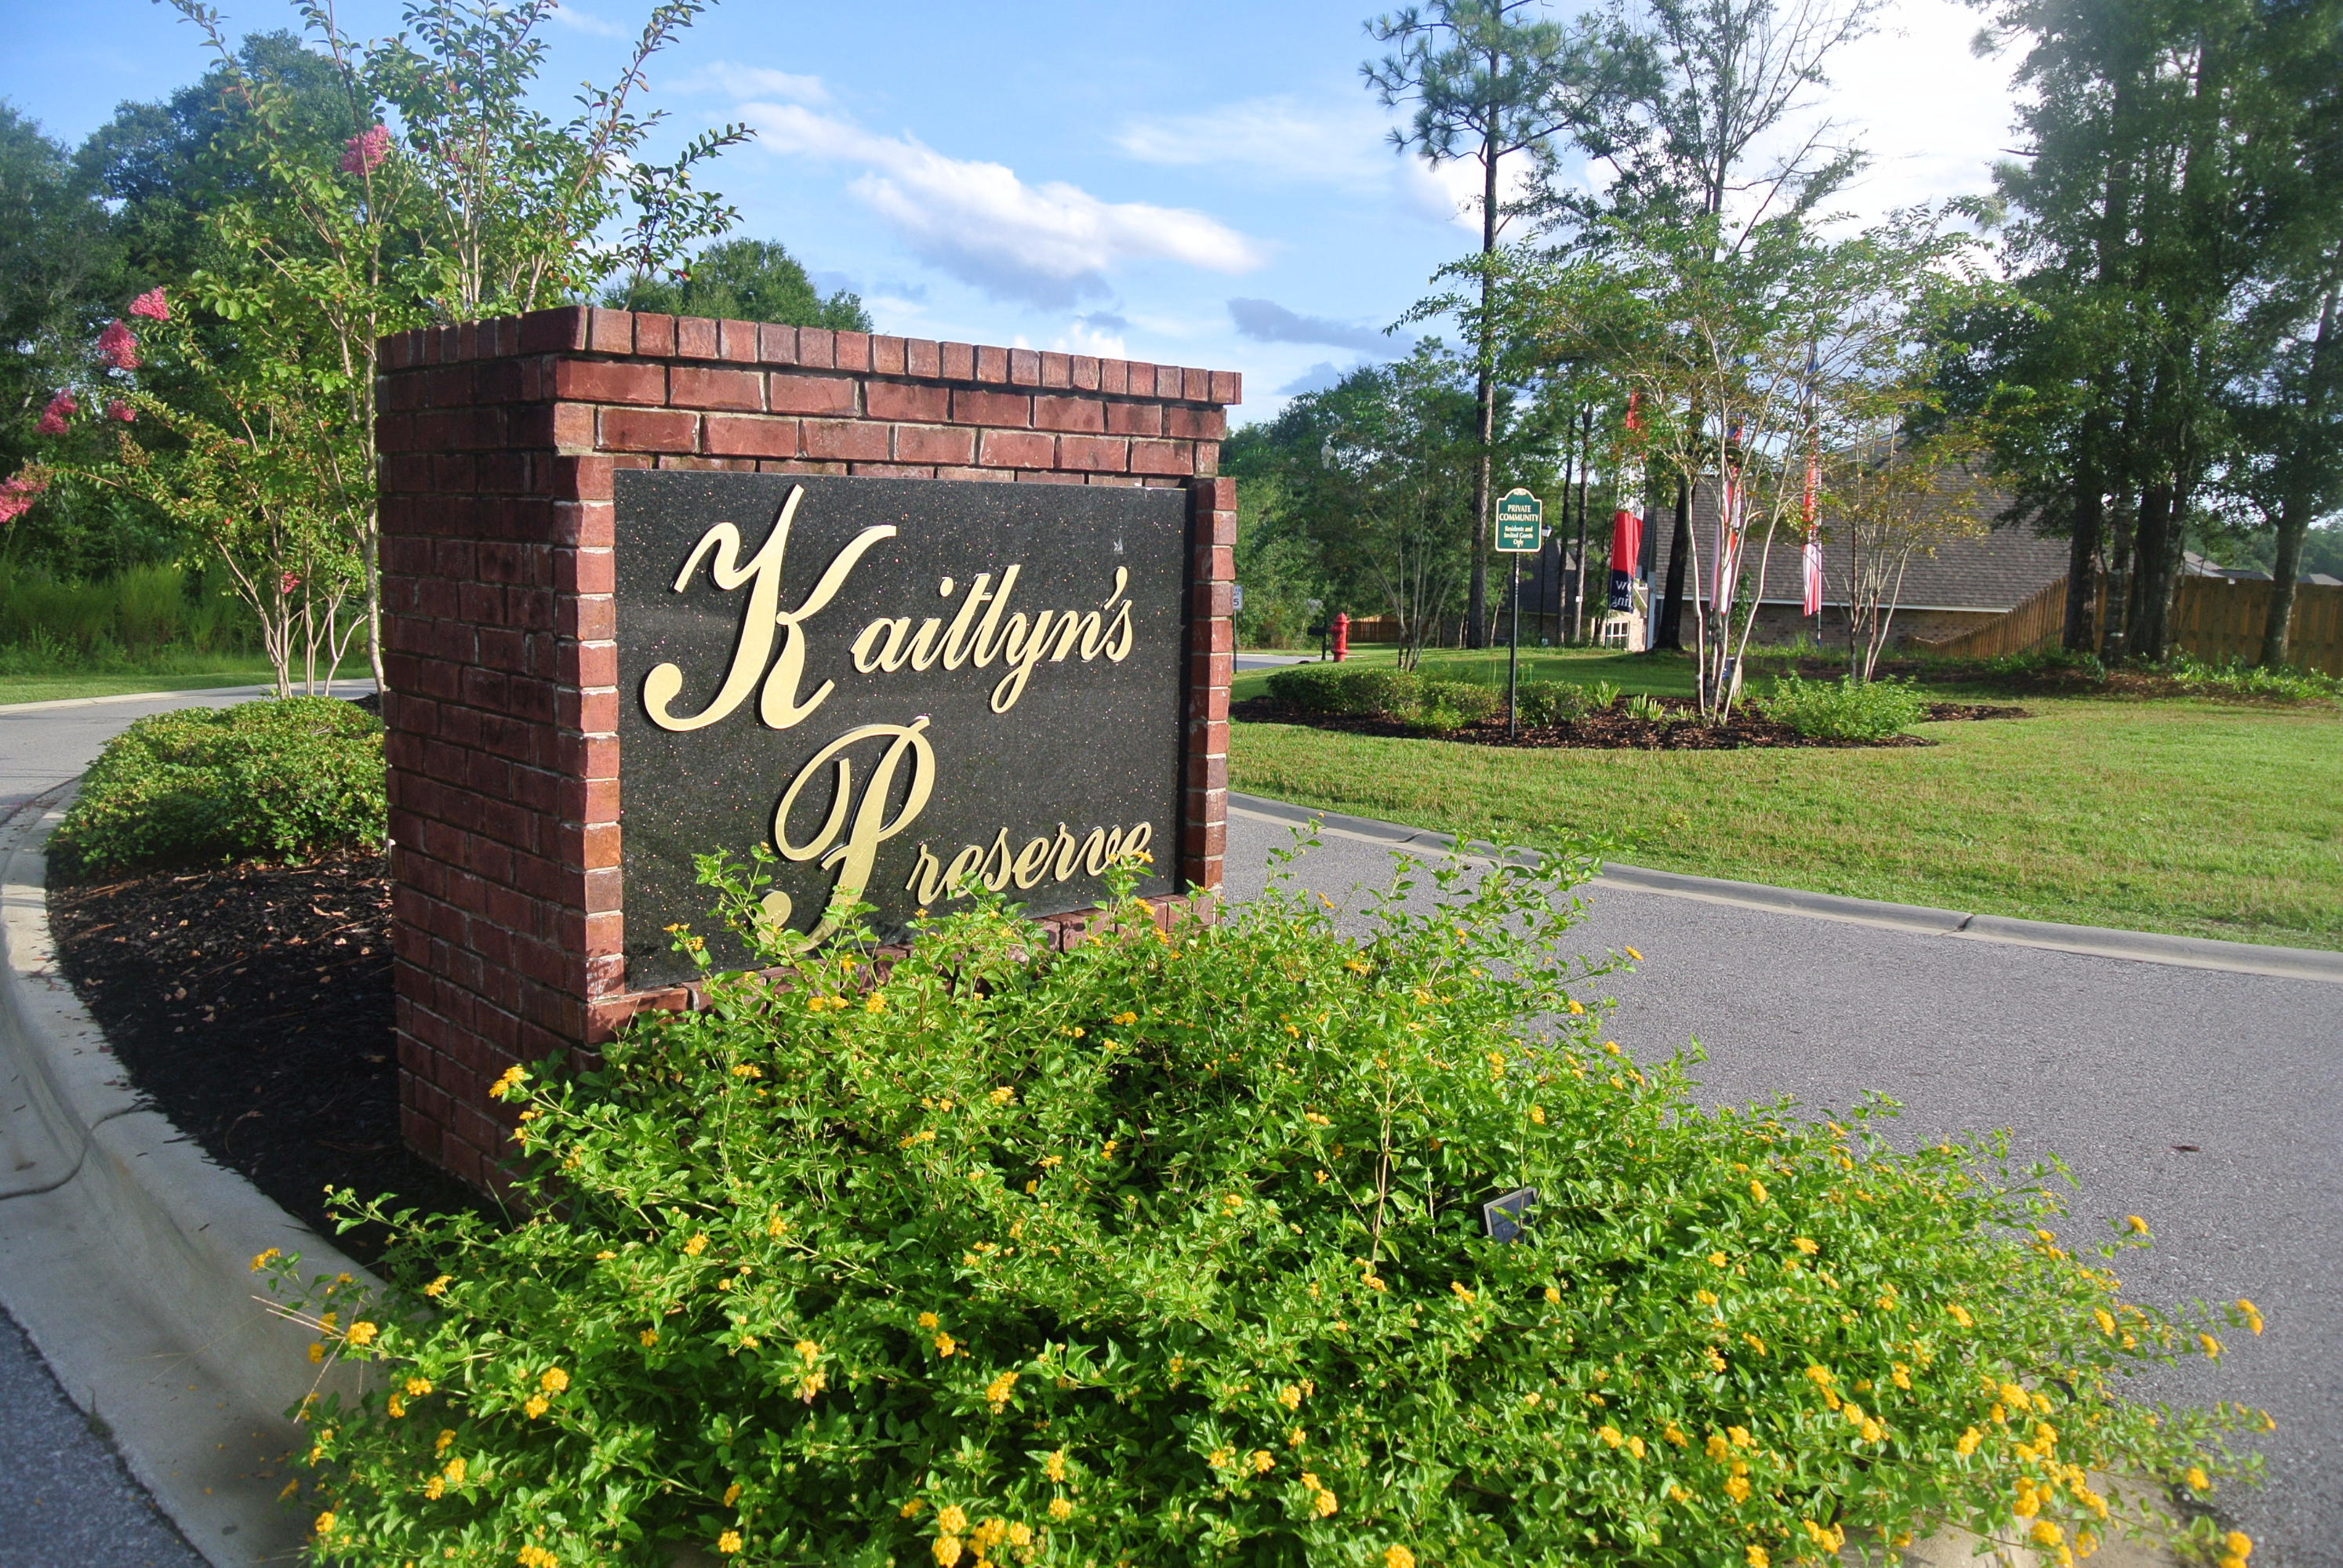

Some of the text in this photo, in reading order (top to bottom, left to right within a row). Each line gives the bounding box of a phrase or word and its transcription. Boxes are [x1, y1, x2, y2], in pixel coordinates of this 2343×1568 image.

[1507, 504, 1531, 513] PRIVATE
[1498, 513, 1539, 521] COMMUNITY
[1513, 539, 1524, 548] Only
[644, 484, 1133, 731] Kaitlyn's
[757, 715, 1154, 954] Preserve
